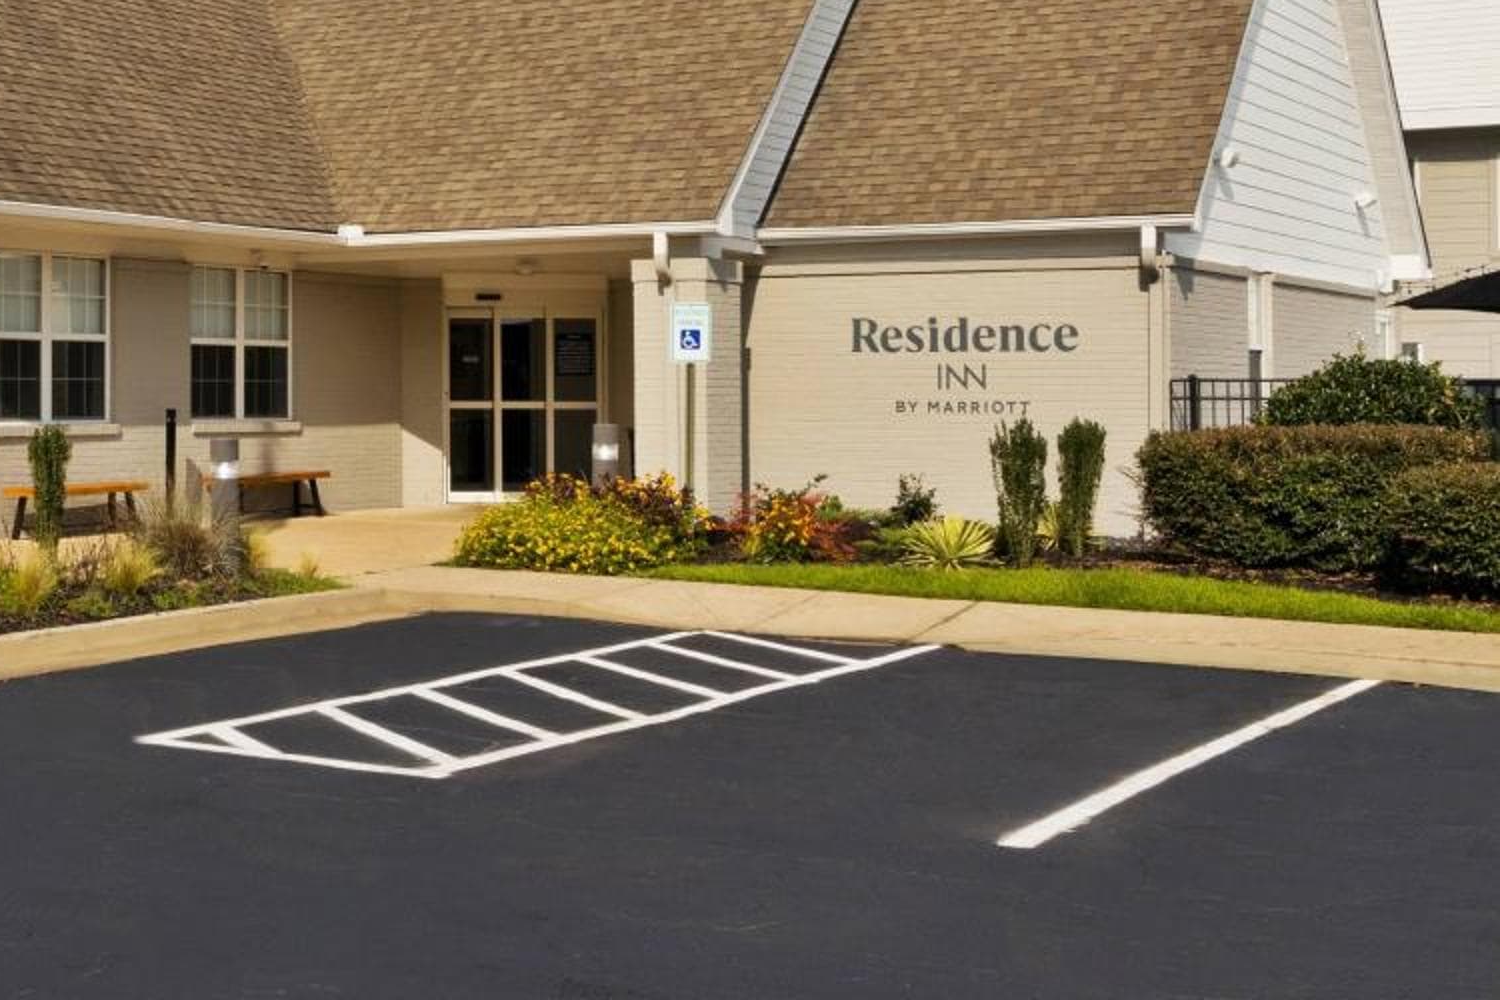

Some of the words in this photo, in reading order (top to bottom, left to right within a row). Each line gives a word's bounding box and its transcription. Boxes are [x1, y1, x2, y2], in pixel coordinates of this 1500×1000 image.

[851, 316, 1079, 352] Residence
[936, 363, 987, 390] INN
[895, 401, 918, 413] BY
[927, 401, 1031, 414] MARRIOTT
